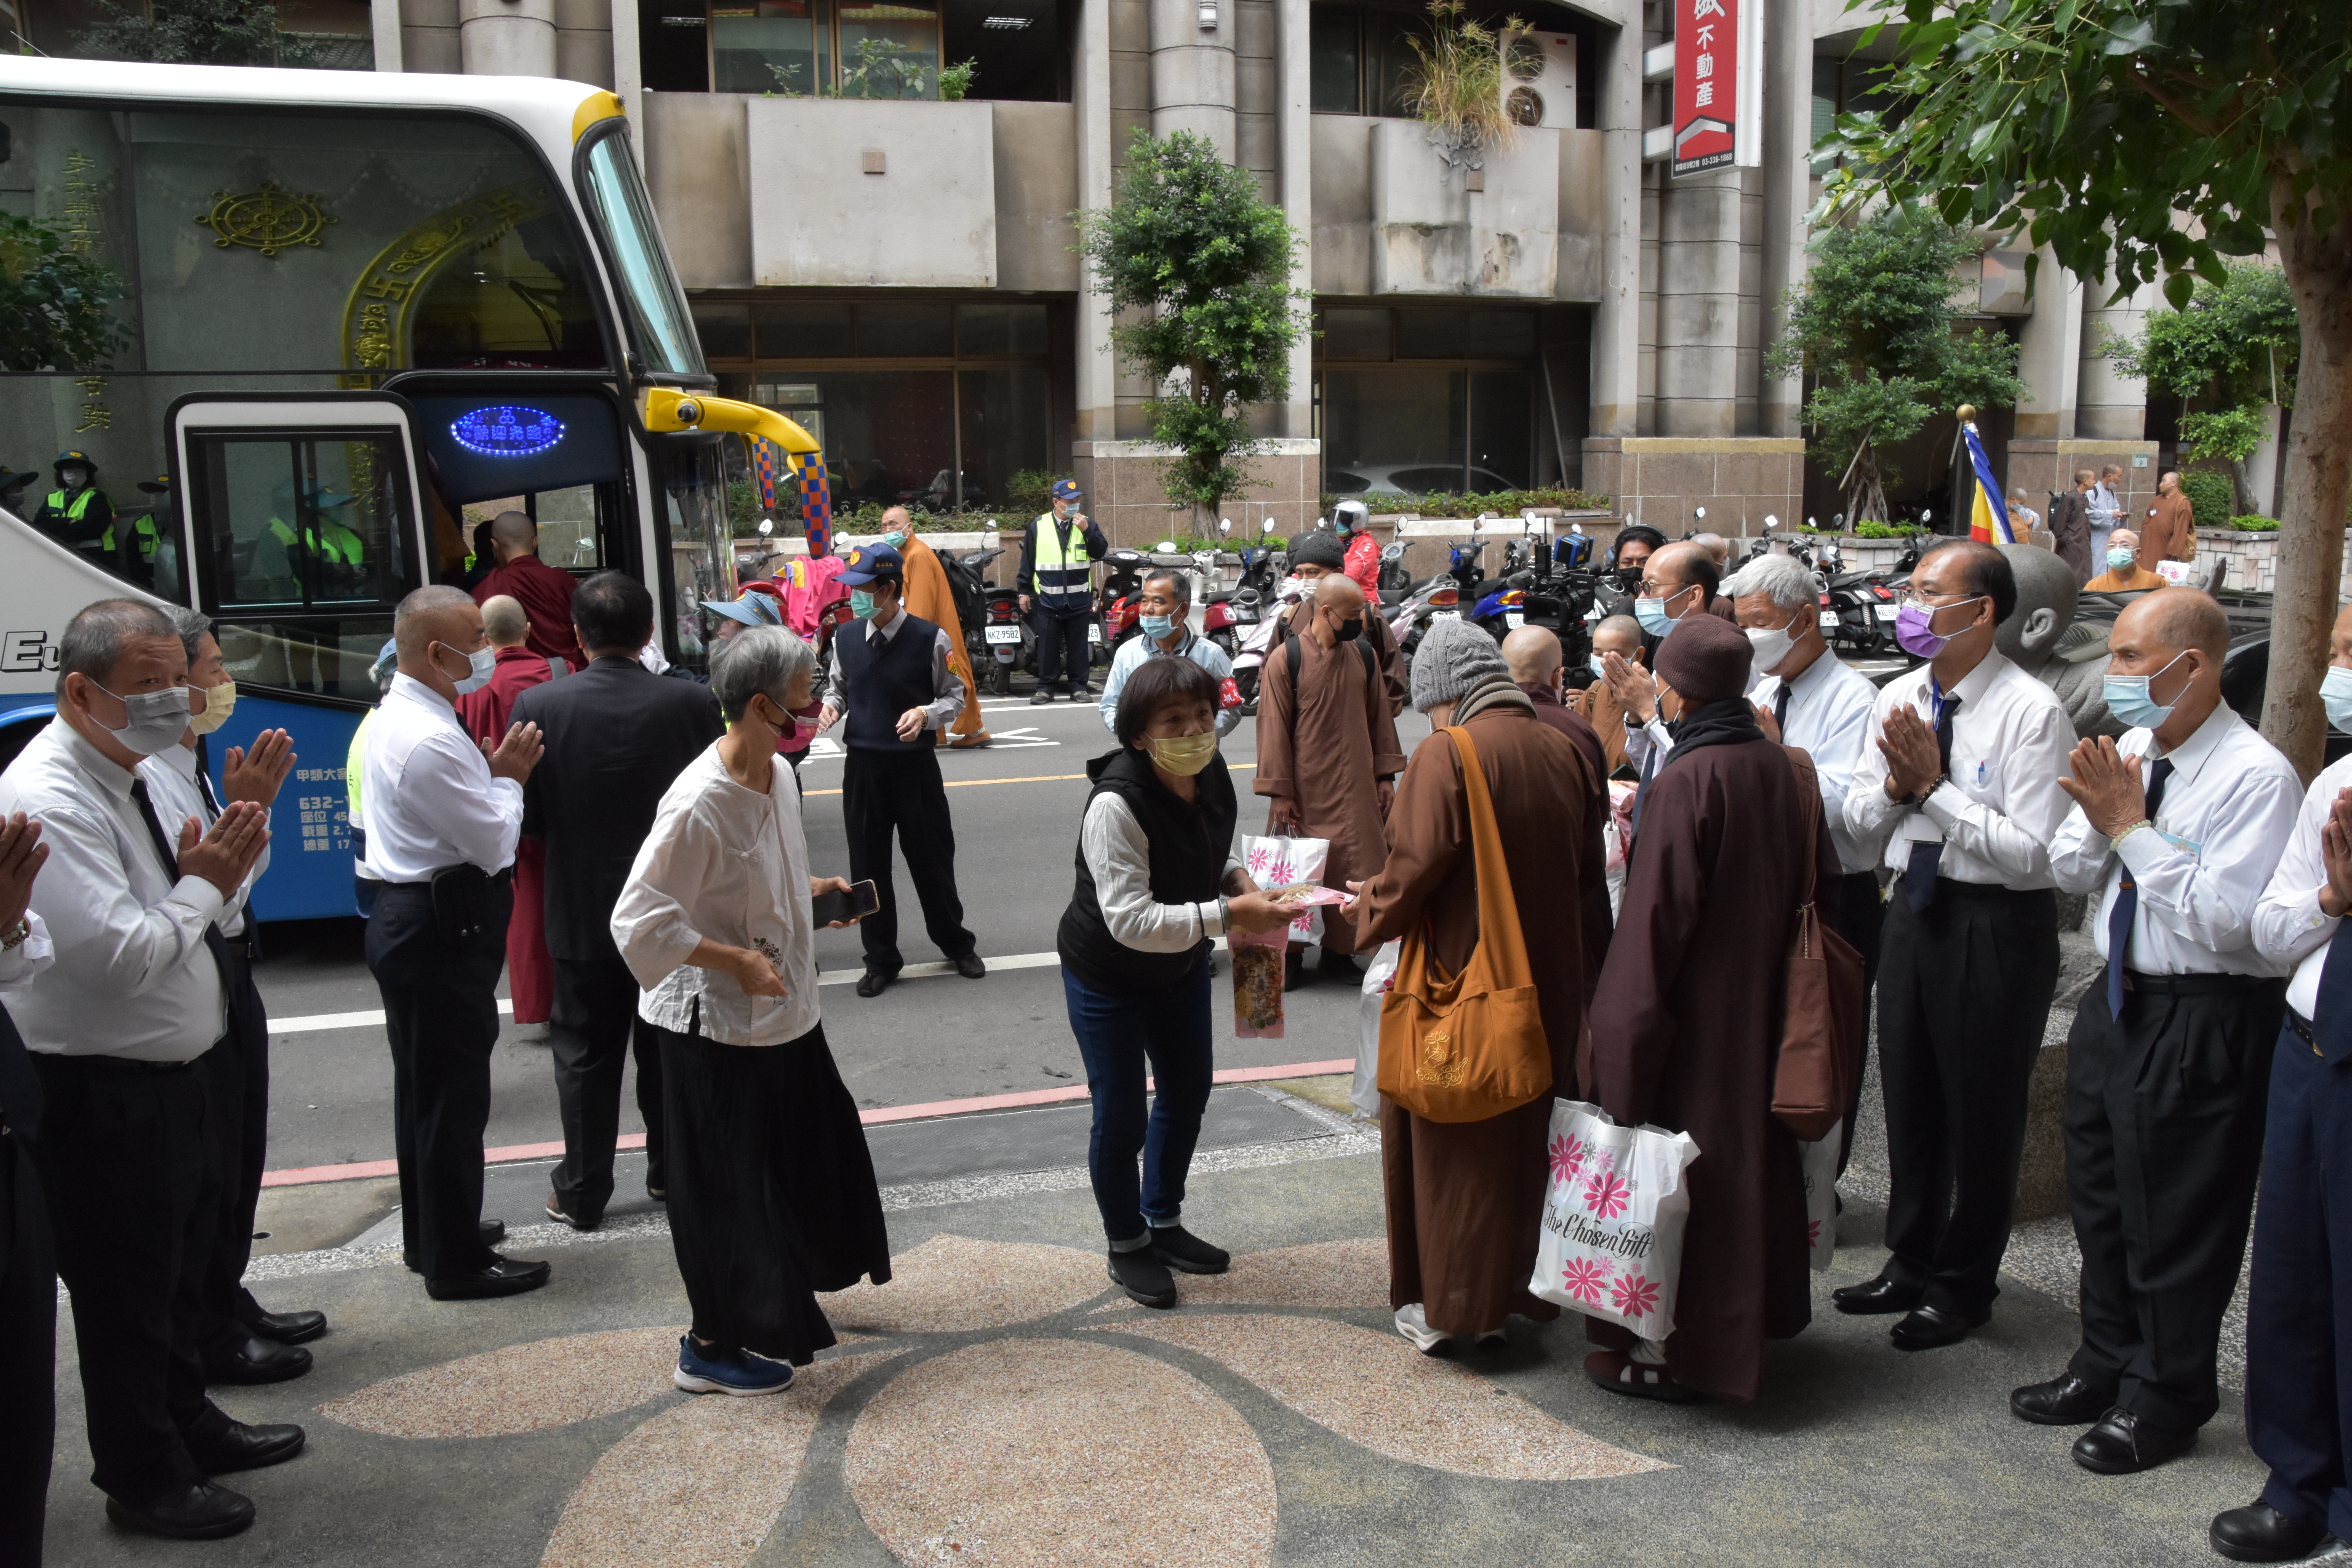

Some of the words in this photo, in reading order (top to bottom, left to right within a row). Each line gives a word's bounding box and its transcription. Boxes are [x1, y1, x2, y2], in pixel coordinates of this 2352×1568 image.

[1702, 153, 1732, 166] 03-336-1868
[474, 425, 543, 441] 歡迎光臨
[301, 810, 327, 823] 座位
[302, 824, 328, 837] 載重
[303, 838, 330, 851] 總重
[1544, 1200, 1563, 1234] The
[1563, 1214, 1619, 1252] Chosen
[1617, 1221, 1655, 1260] Gift
